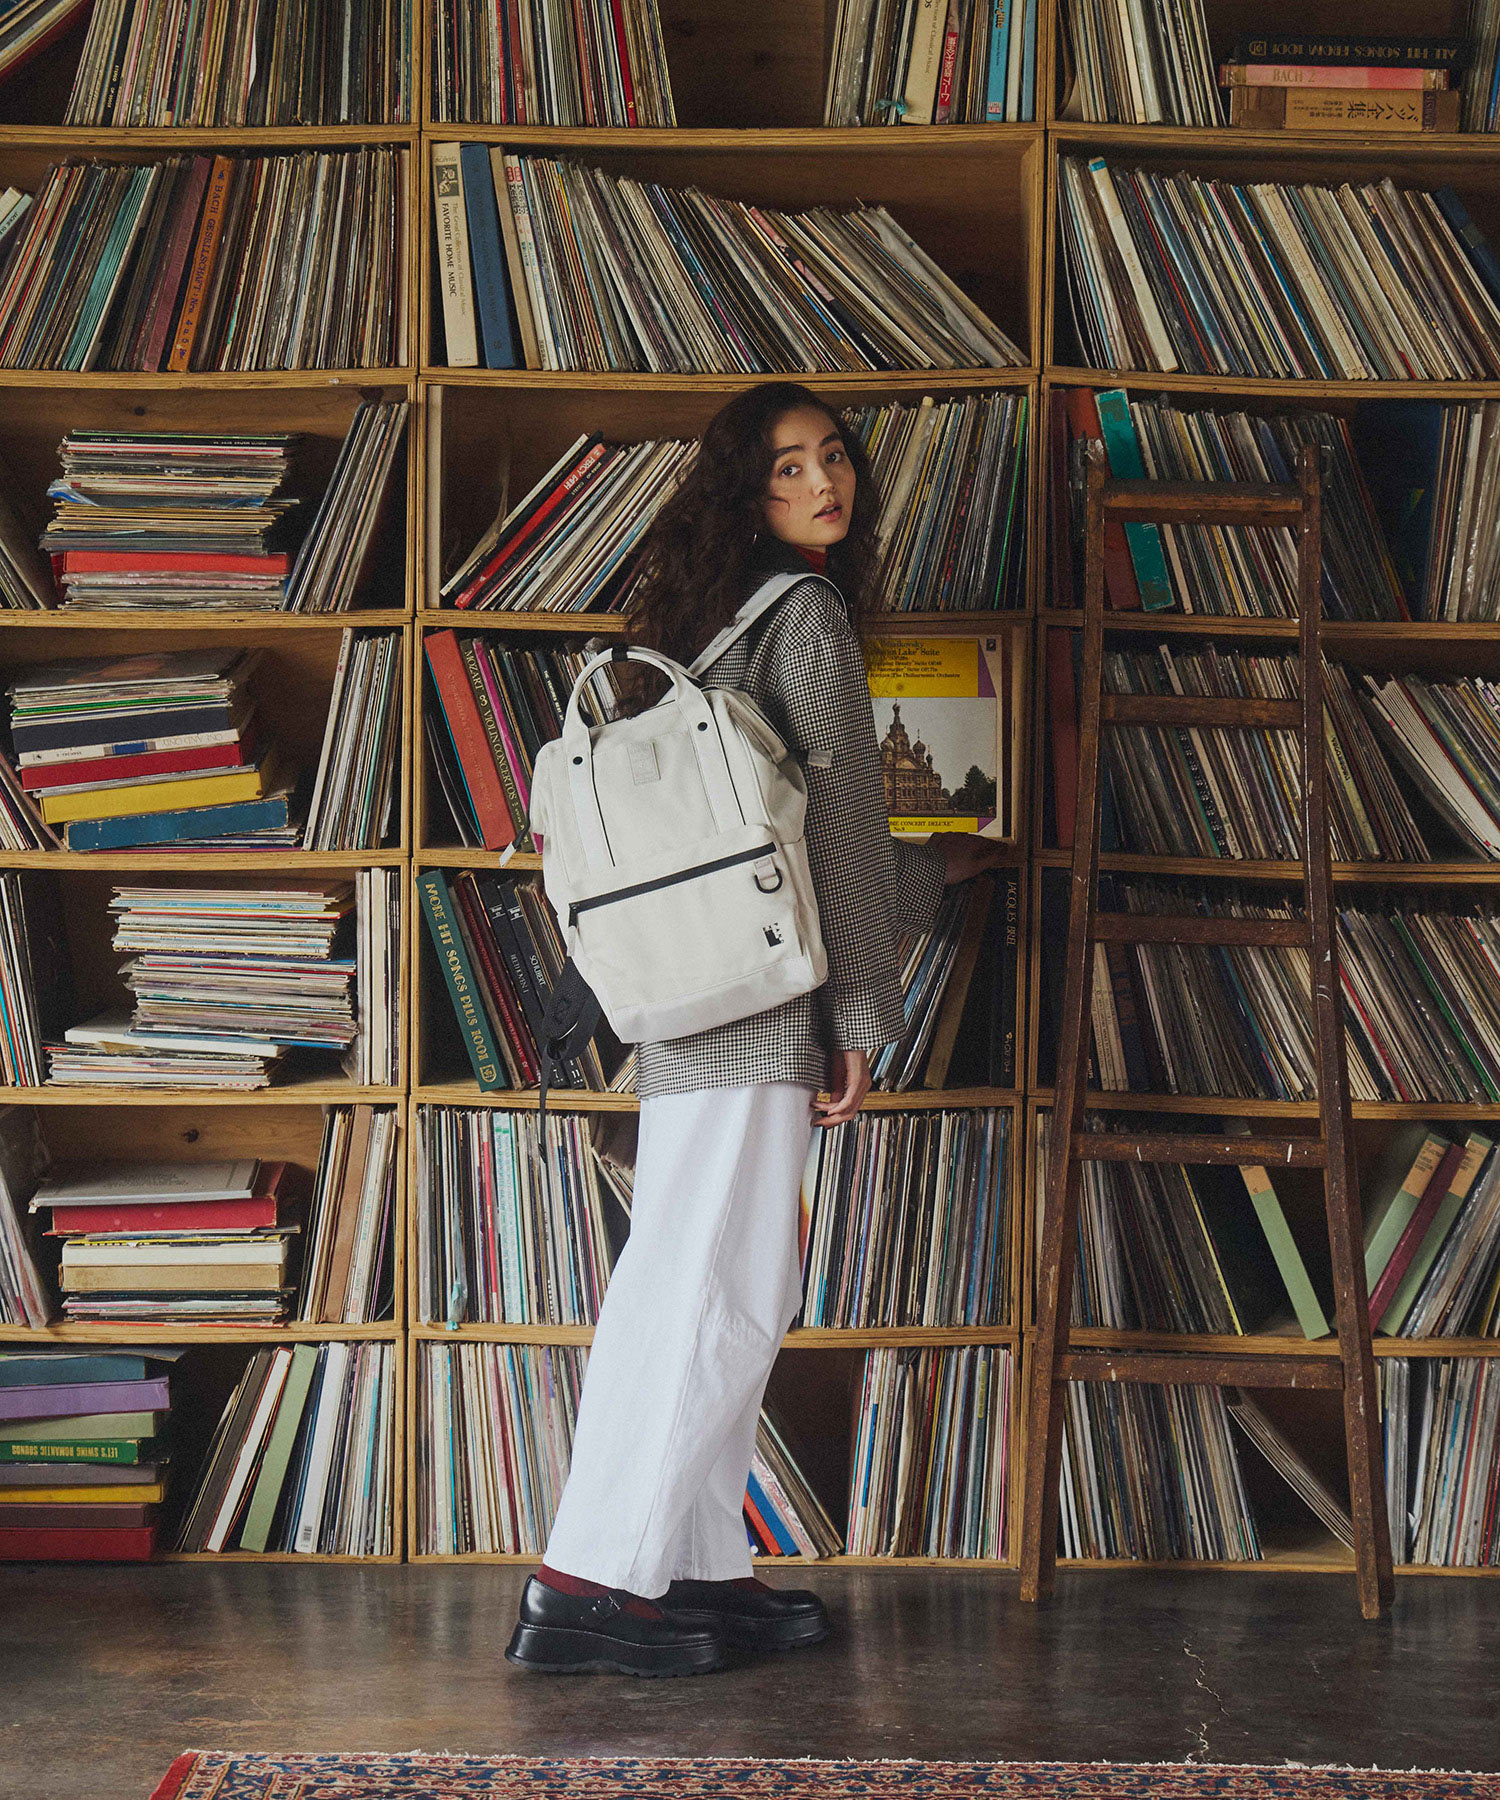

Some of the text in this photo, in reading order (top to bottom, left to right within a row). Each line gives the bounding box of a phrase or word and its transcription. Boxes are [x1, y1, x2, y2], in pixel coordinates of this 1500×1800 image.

[1309, 45, 1350, 57] FROM
[1354, 45, 1400, 57] SONGS
[1407, 47, 1428, 58] HIT
[1433, 48, 1457, 59] ALL
[1273, 69, 1303, 82] BACH
[210, 185, 223, 213] BACH
[442, 203, 457, 297] FAVORITE HOME MUSIC
[576, 456, 596, 476] PERCY
[920, 648, 940, 656] Suite
[464, 651, 484, 692] MOZART
[482, 709, 499, 743] VIOLIN
[492, 743, 517, 800] CONCERTOS
[1007, 881, 1016, 947] JACQUES BREL
[425, 882, 490, 1061] MORE HIT SONGS PLUS 1001
[11, 1445, 118, 1457] LET'S SWING ROMANTIC SOUNDS
